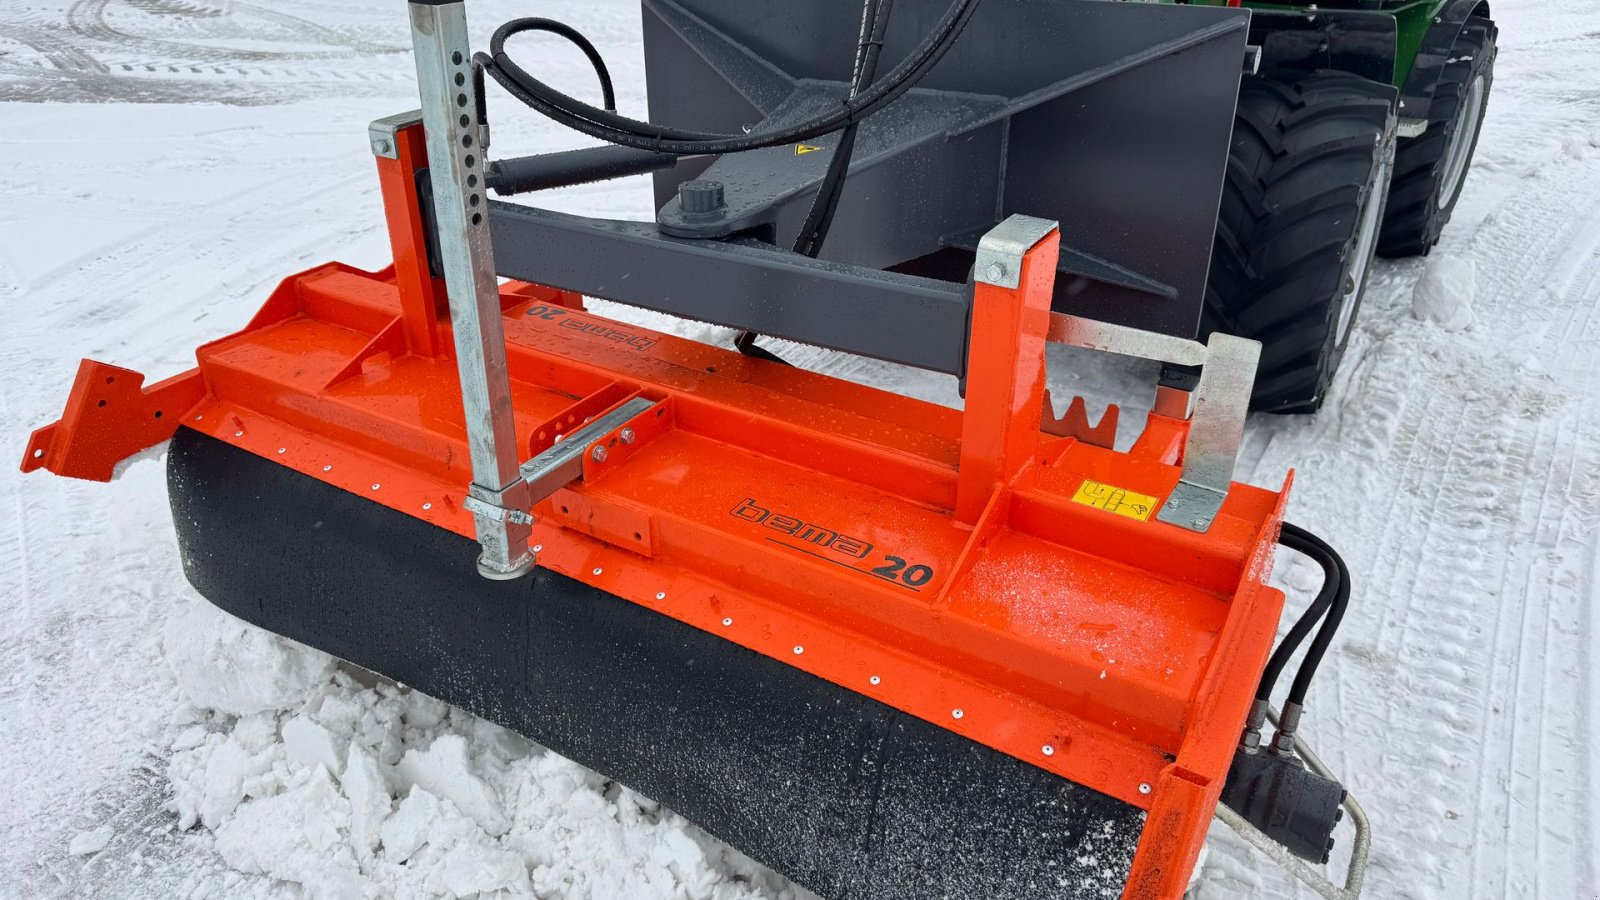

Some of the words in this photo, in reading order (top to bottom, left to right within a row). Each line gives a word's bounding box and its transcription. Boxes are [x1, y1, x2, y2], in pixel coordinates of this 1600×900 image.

[518, 91, 547, 112] DUNLOP
[525, 305, 568, 320] 20
[558, 318, 657, 351] bema
[729, 497, 874, 559] bema
[871, 554, 934, 587] 20
